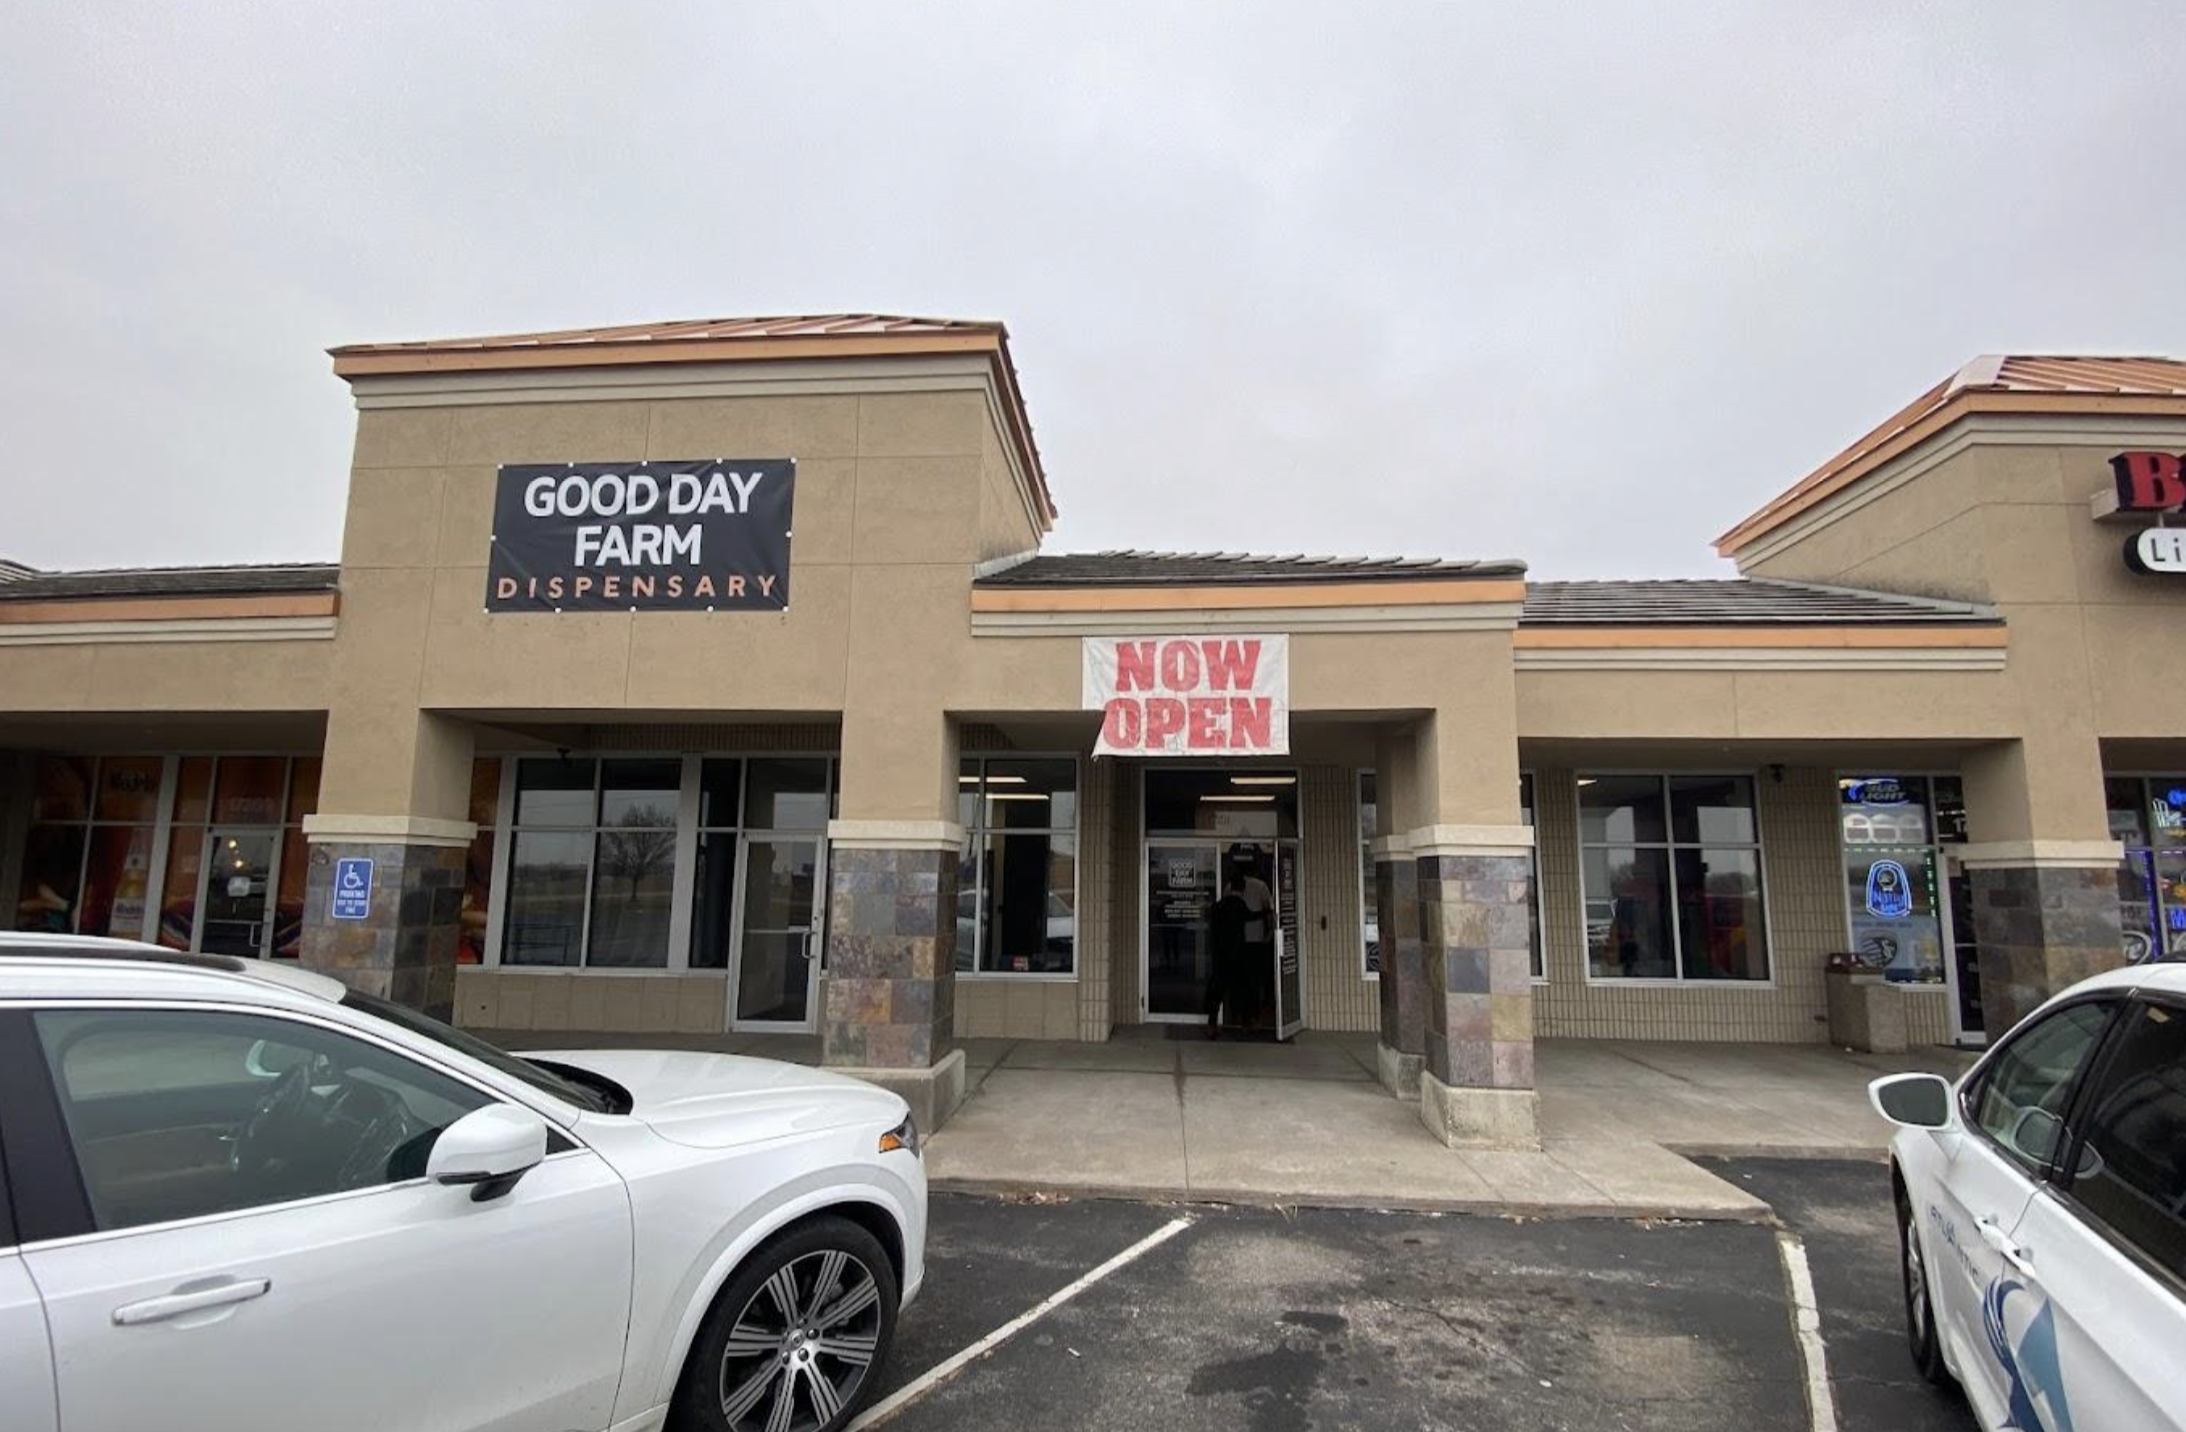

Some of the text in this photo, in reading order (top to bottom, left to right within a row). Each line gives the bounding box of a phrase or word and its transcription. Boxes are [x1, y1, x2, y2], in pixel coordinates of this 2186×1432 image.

[524, 472, 763, 517] GOOD DAY
[2108, 451, 2186, 512] B
[574, 523, 703, 567] FARM
[496, 573, 778, 600] DISPENSARY
[1114, 639, 1262, 692] NOW
[1102, 697, 1273, 749] OPEN
